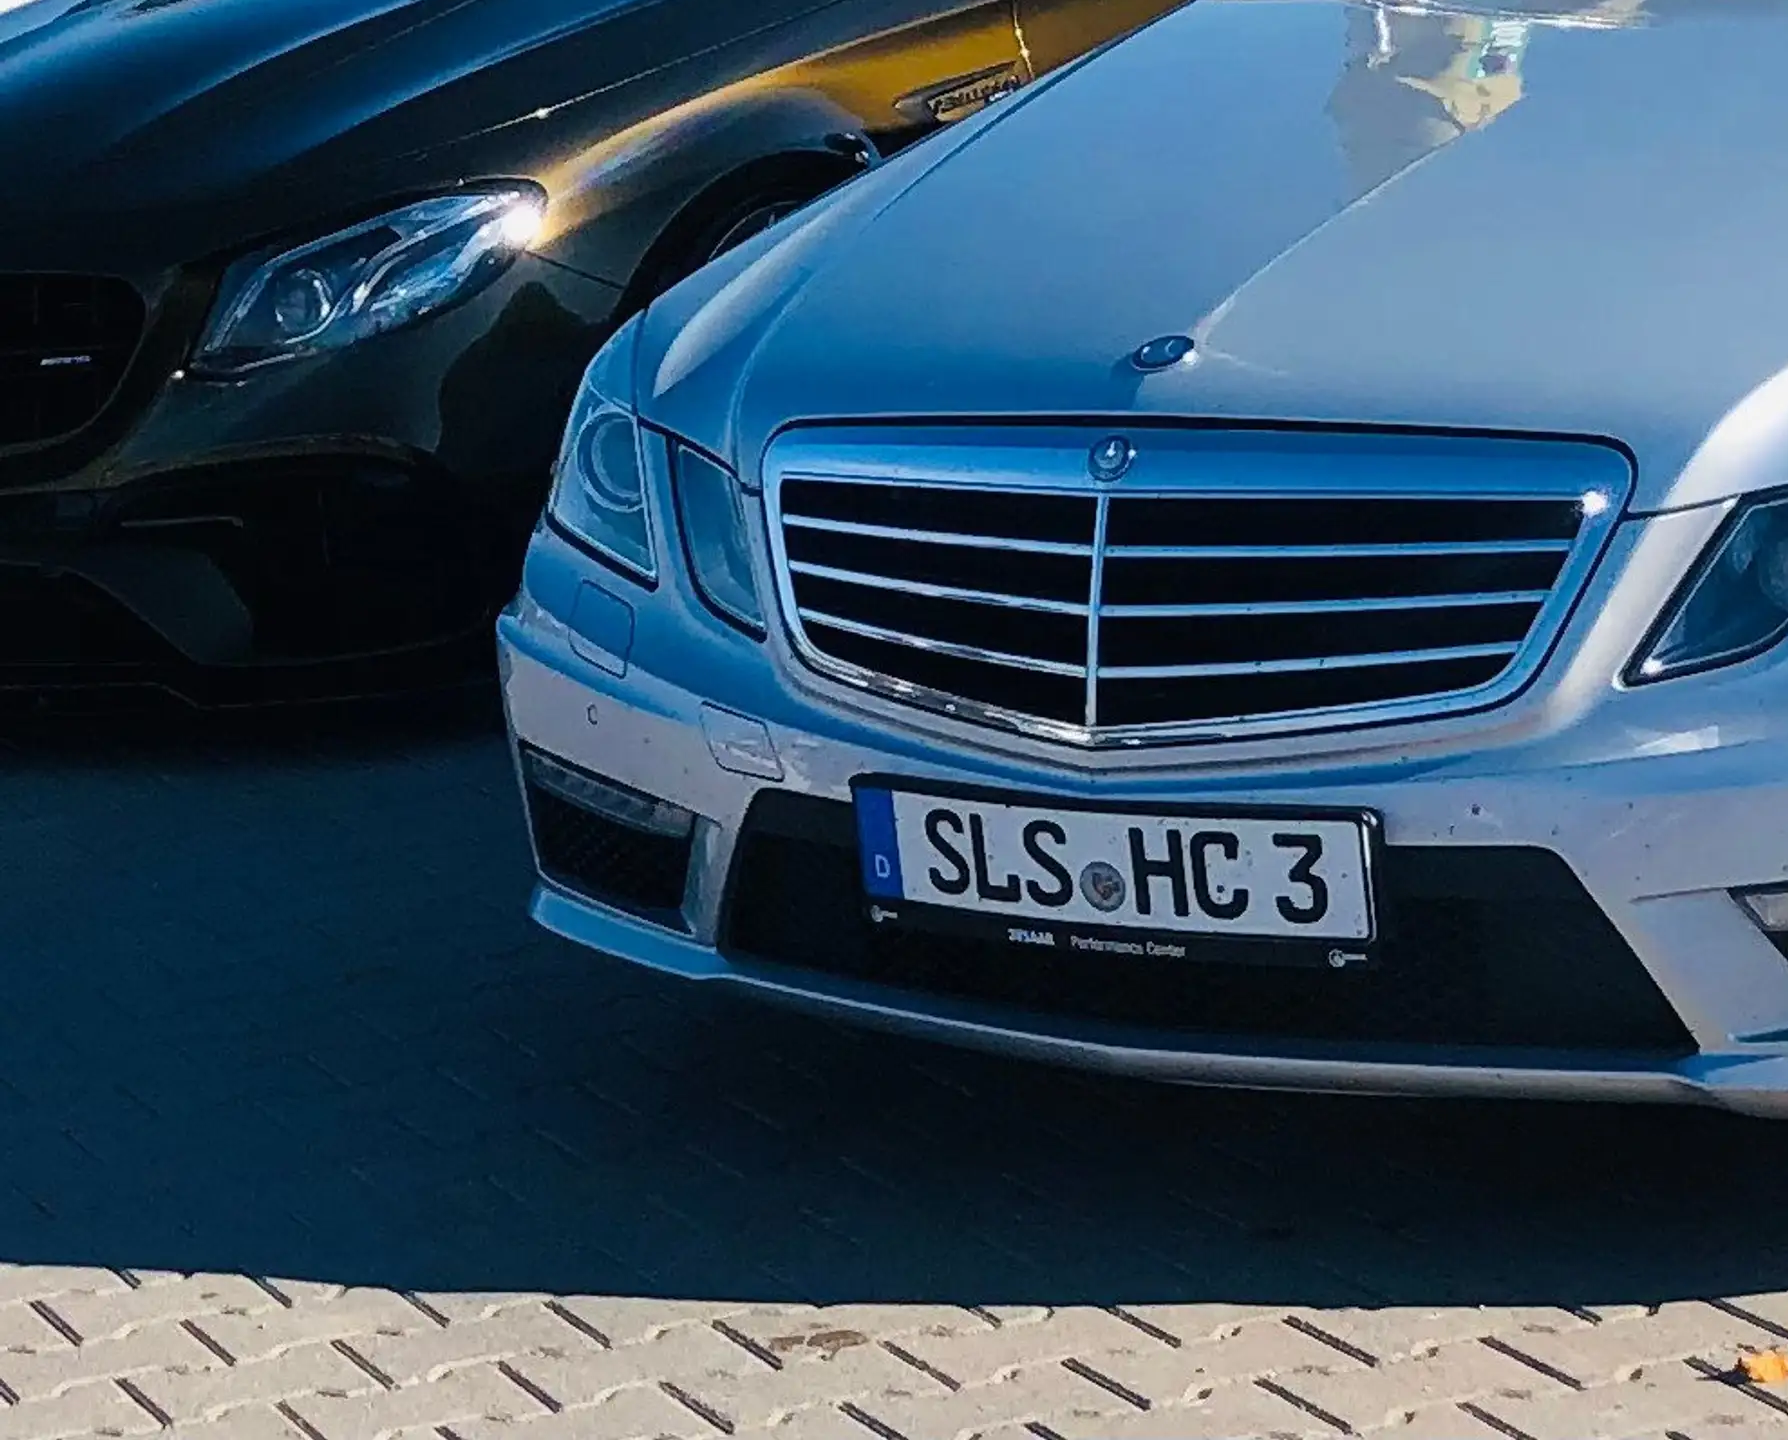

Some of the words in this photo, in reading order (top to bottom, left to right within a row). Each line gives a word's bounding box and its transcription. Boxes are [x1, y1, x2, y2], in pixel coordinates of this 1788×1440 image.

[875, 853, 891, 879] D
[924, 808, 1075, 908] SLS
[1127, 826, 1250, 920] HC
[1271, 832, 1329, 925] 3
